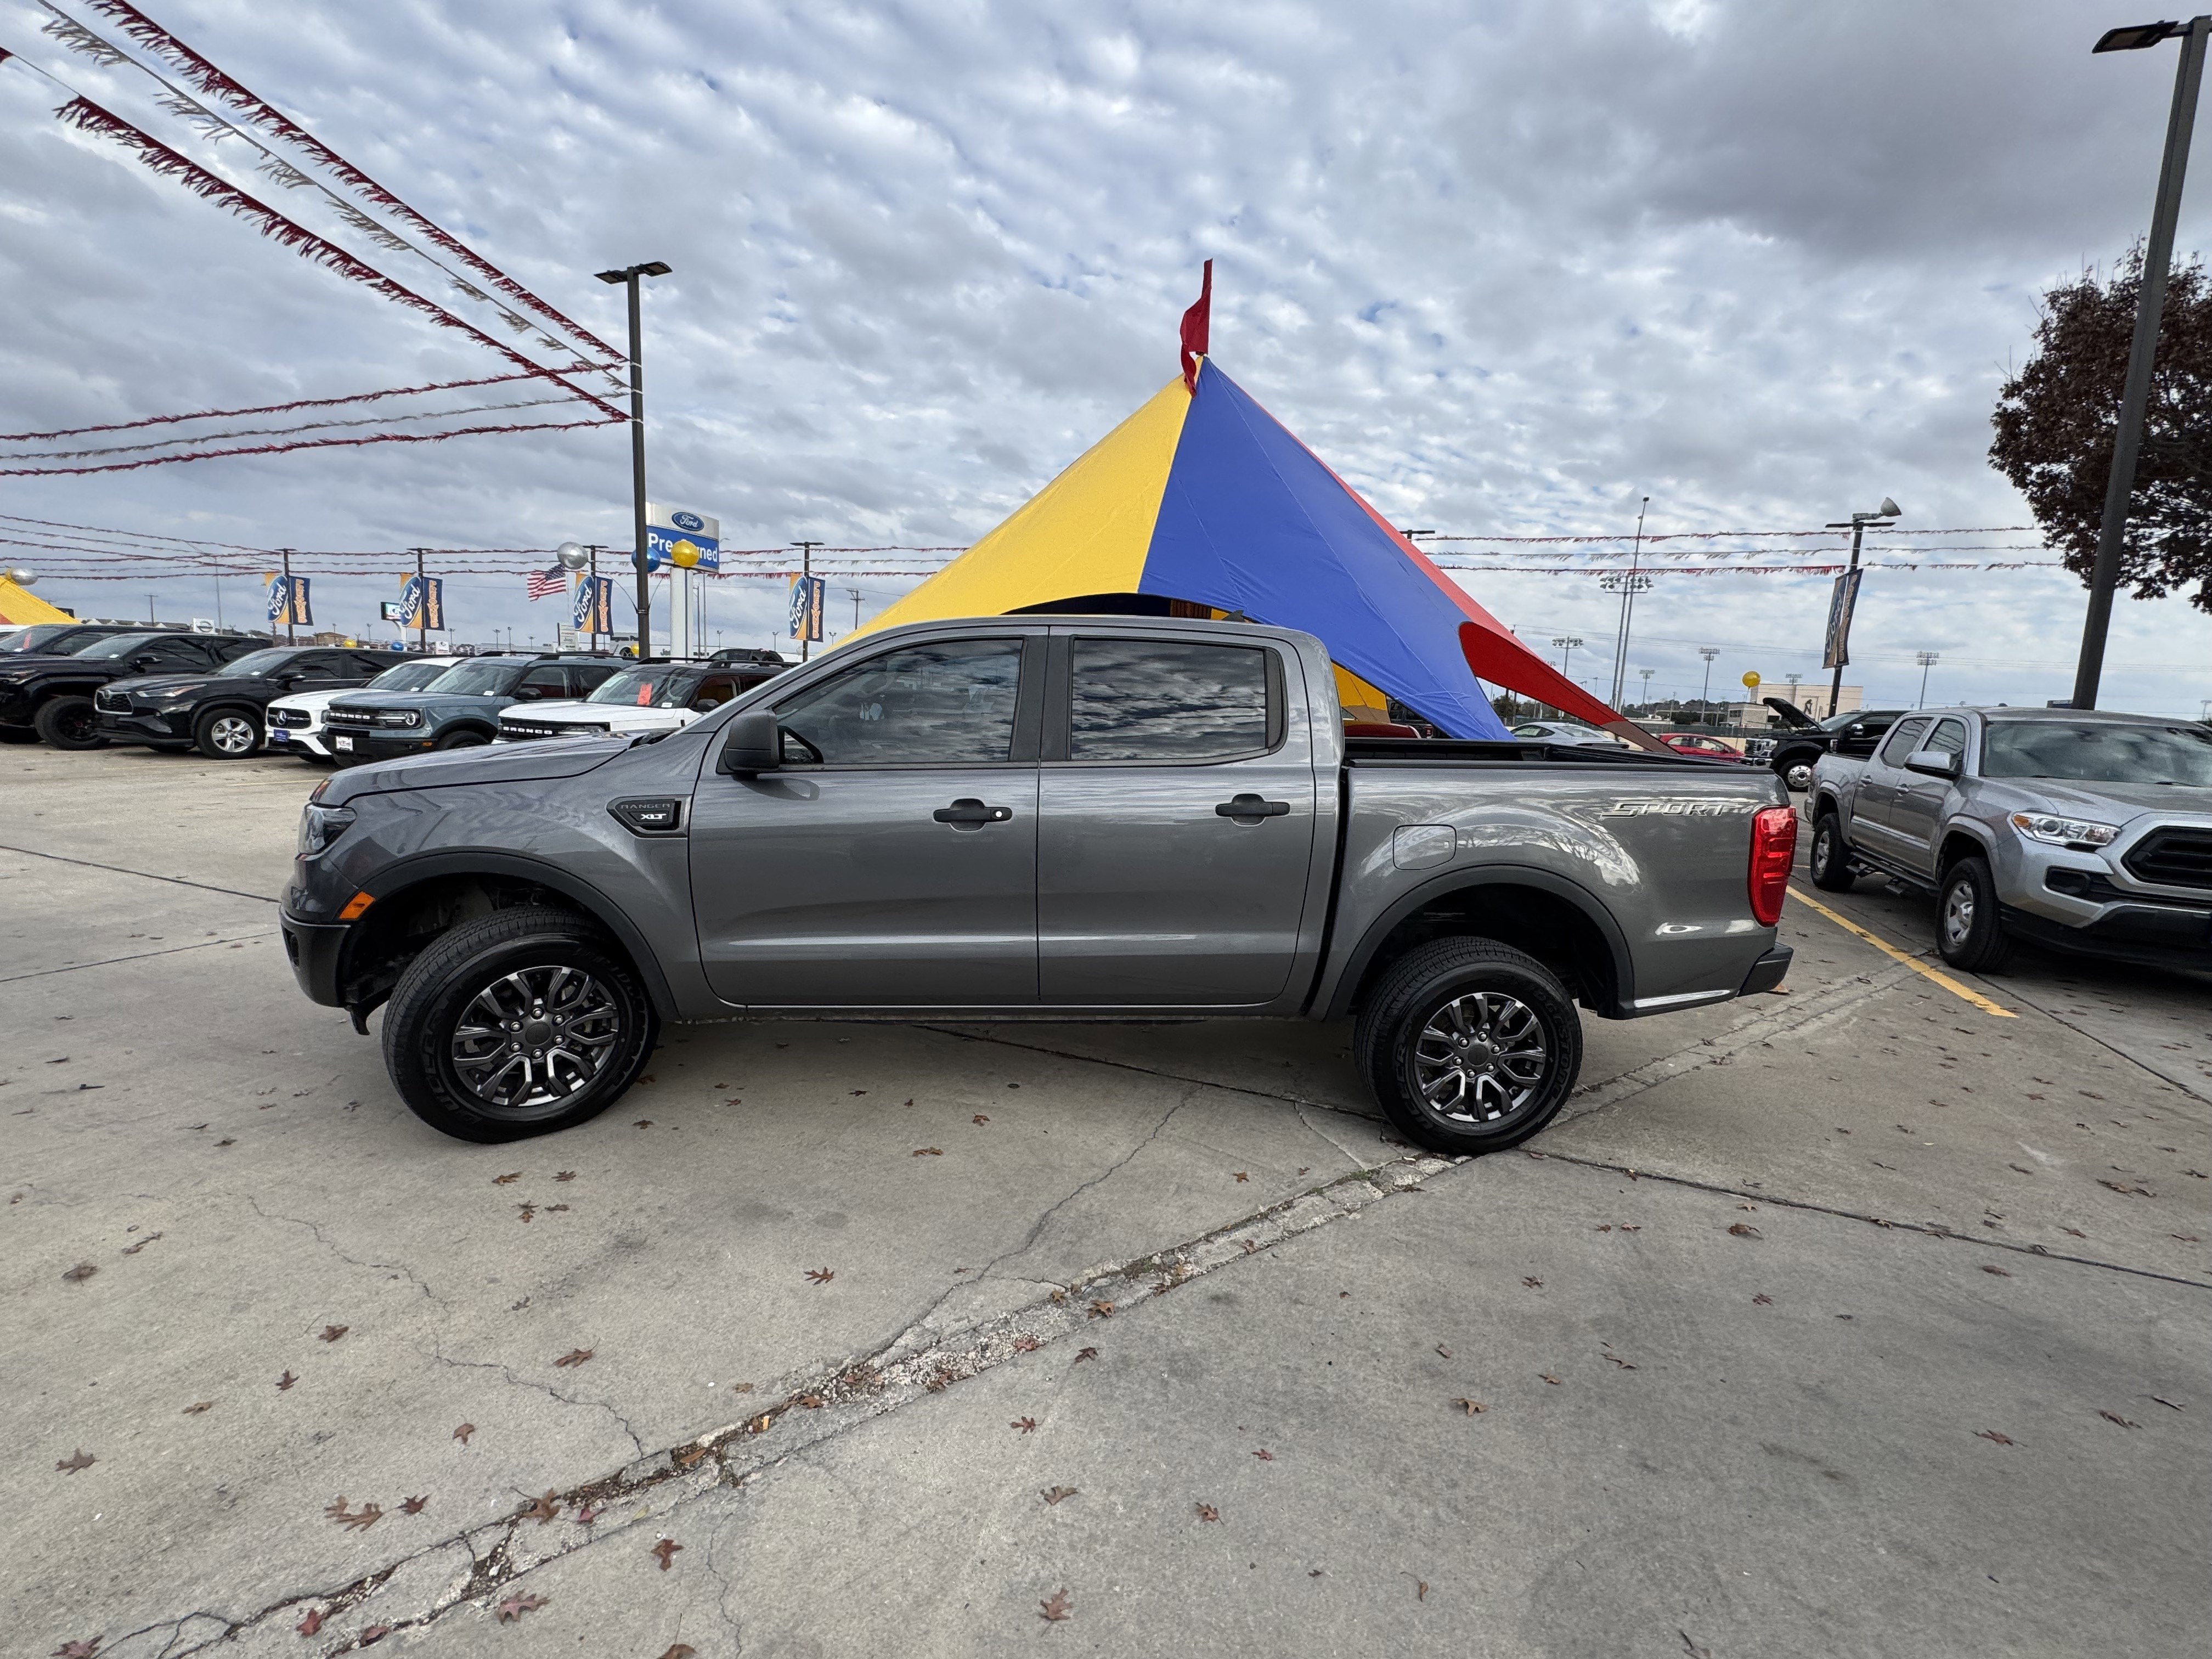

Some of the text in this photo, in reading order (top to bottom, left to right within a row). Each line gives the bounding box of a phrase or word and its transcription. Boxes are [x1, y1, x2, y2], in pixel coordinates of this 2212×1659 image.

[680, 515, 699, 528] Ford
[648, 532, 718, 563] Prened
[267, 582, 286, 616] Ford
[400, 583, 421, 619] Ford
[573, 583, 592, 623] Ford
[789, 585, 806, 629] Ford
[1826, 591, 1843, 653] Ford
[330, 712, 371, 720] BRONCO
[503, 726, 553, 735] BRONCO
[1600, 802, 1738, 819] SPORT
